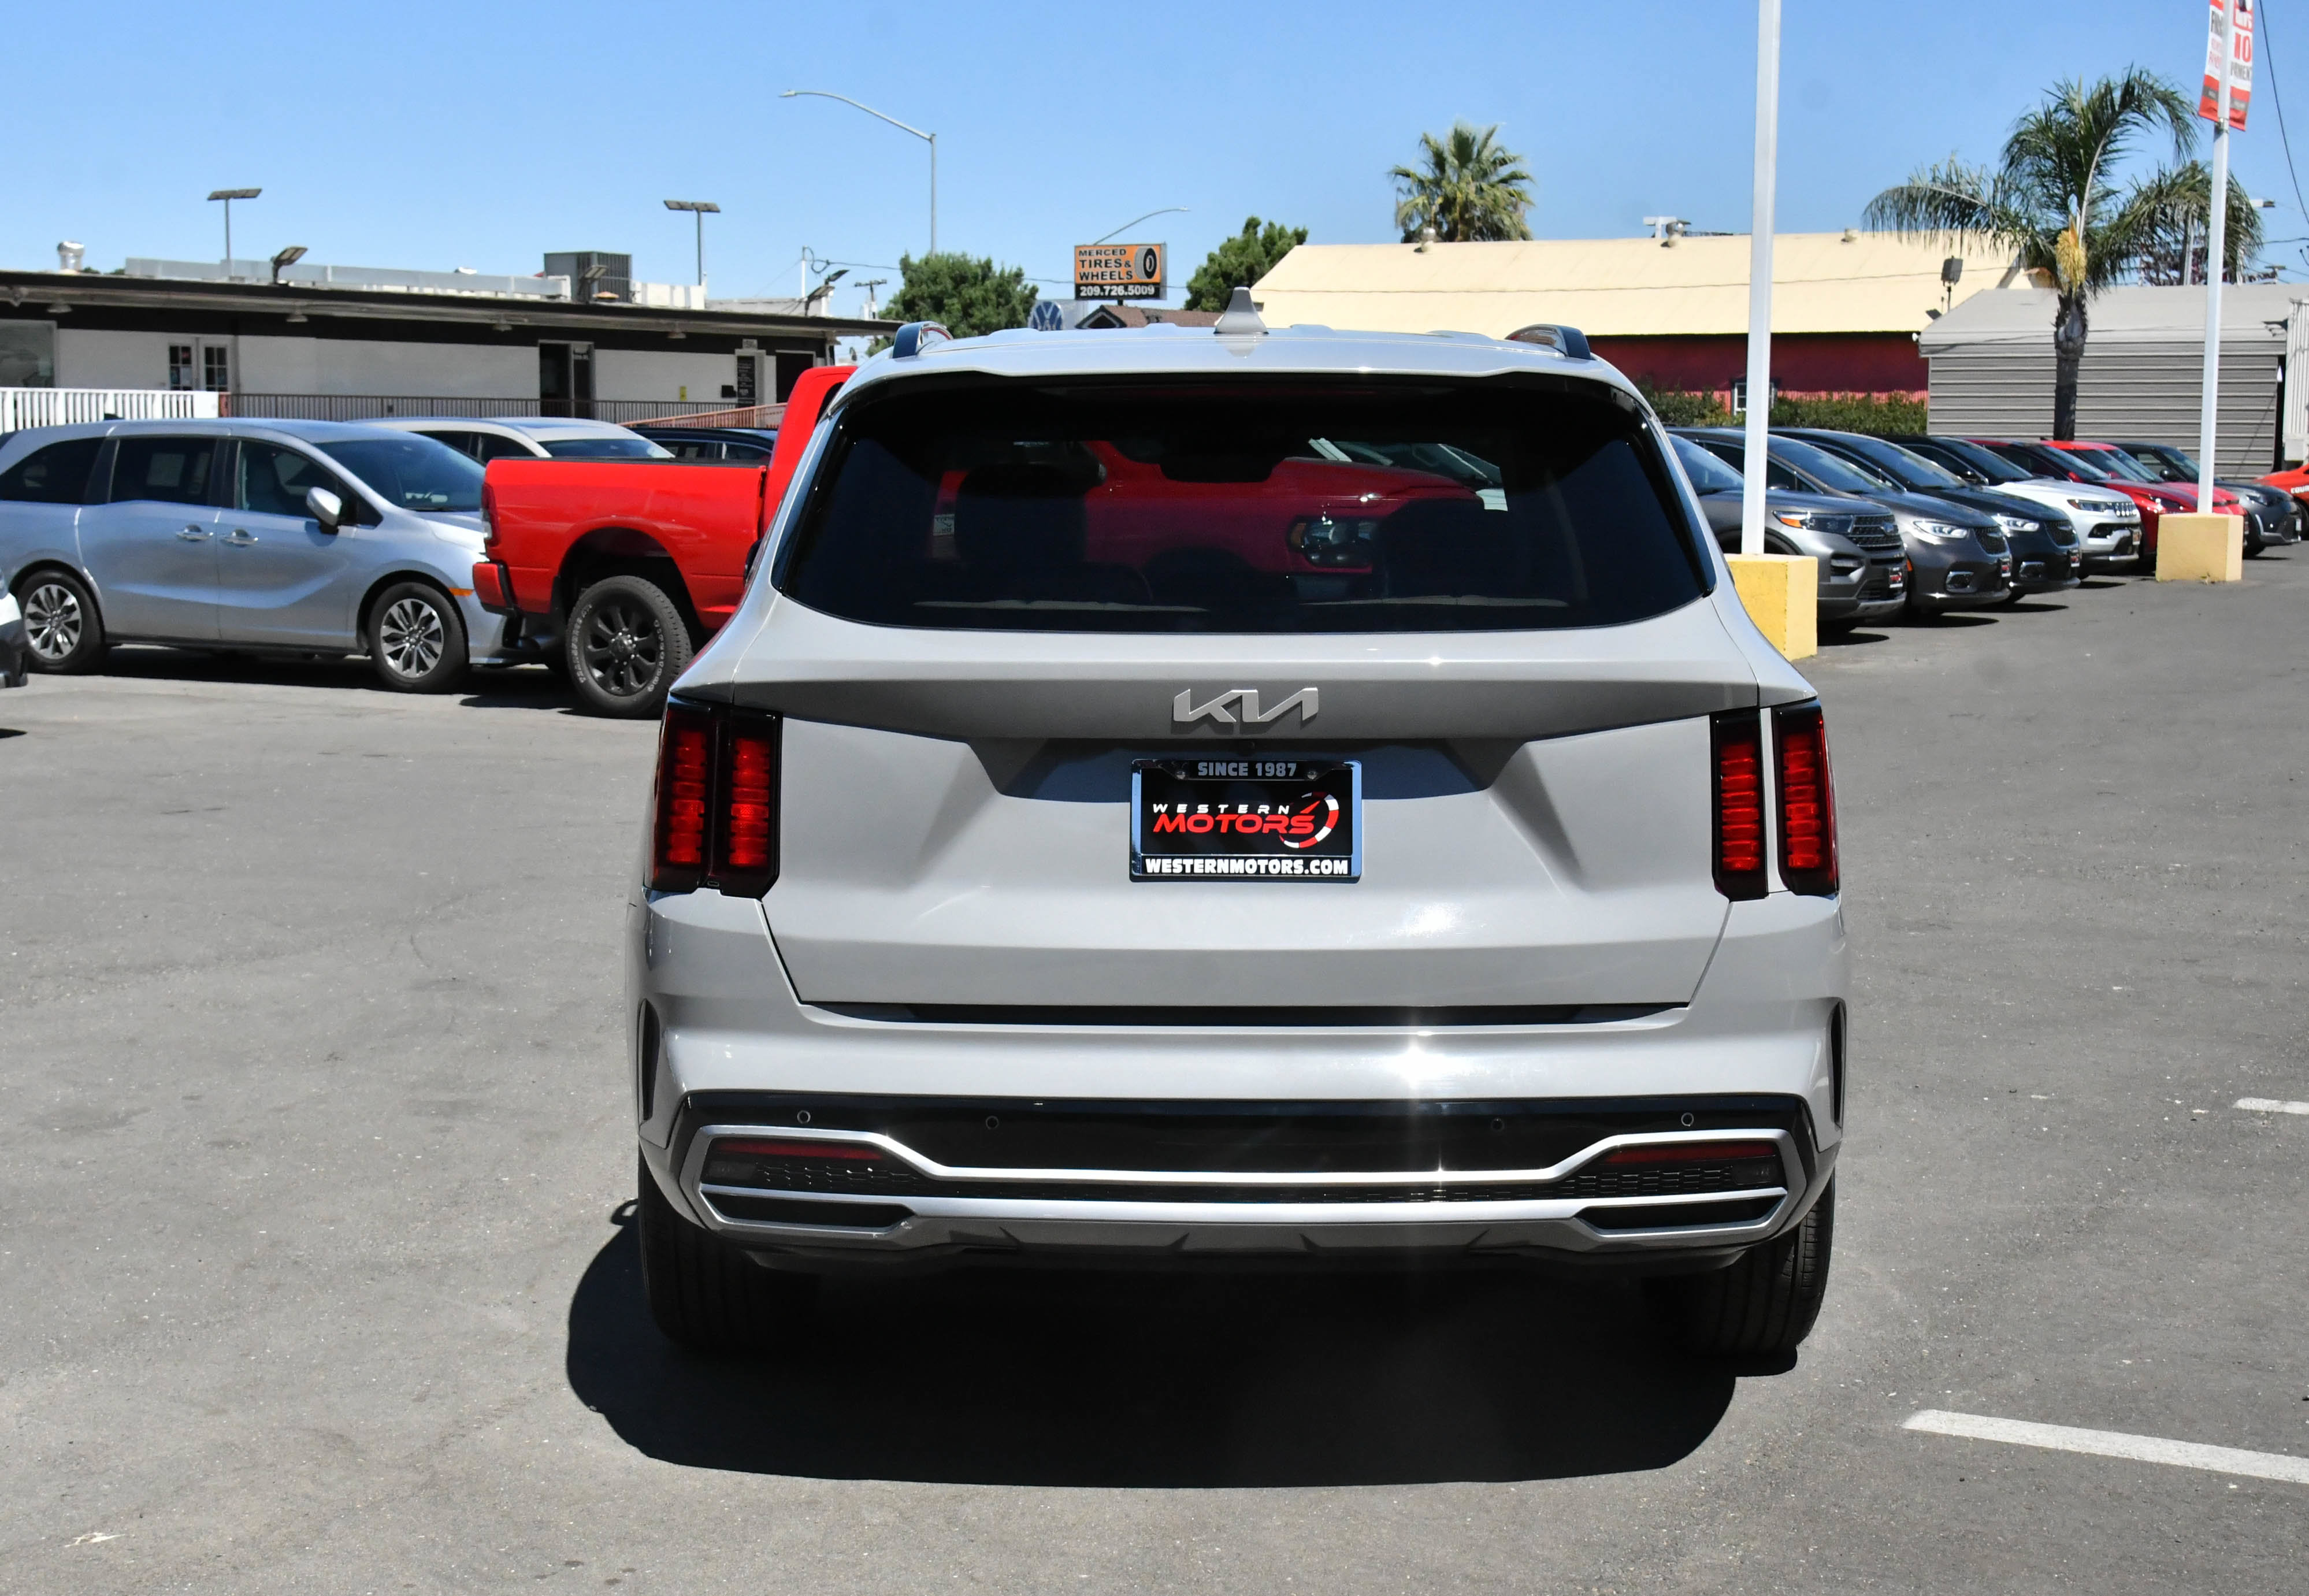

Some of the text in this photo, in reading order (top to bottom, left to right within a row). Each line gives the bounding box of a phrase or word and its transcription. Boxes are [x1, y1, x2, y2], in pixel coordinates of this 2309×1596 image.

[2234, 32, 2251, 62] 10
[1079, 248, 1126, 257] MERCED
[1079, 259, 1122, 269] TIRES
[1079, 270, 1133, 281] WHEELS
[1079, 285, 1155, 296] 209.726.5009
[1174, 687, 1318, 722] KIA
[1198, 762, 1297, 777] SINCE 1987
[1153, 803, 1290, 814] WESTERN
[1153, 814, 1315, 834] MOTORS
[1145, 859, 1348, 875] WESTERNMOTORS.COM
